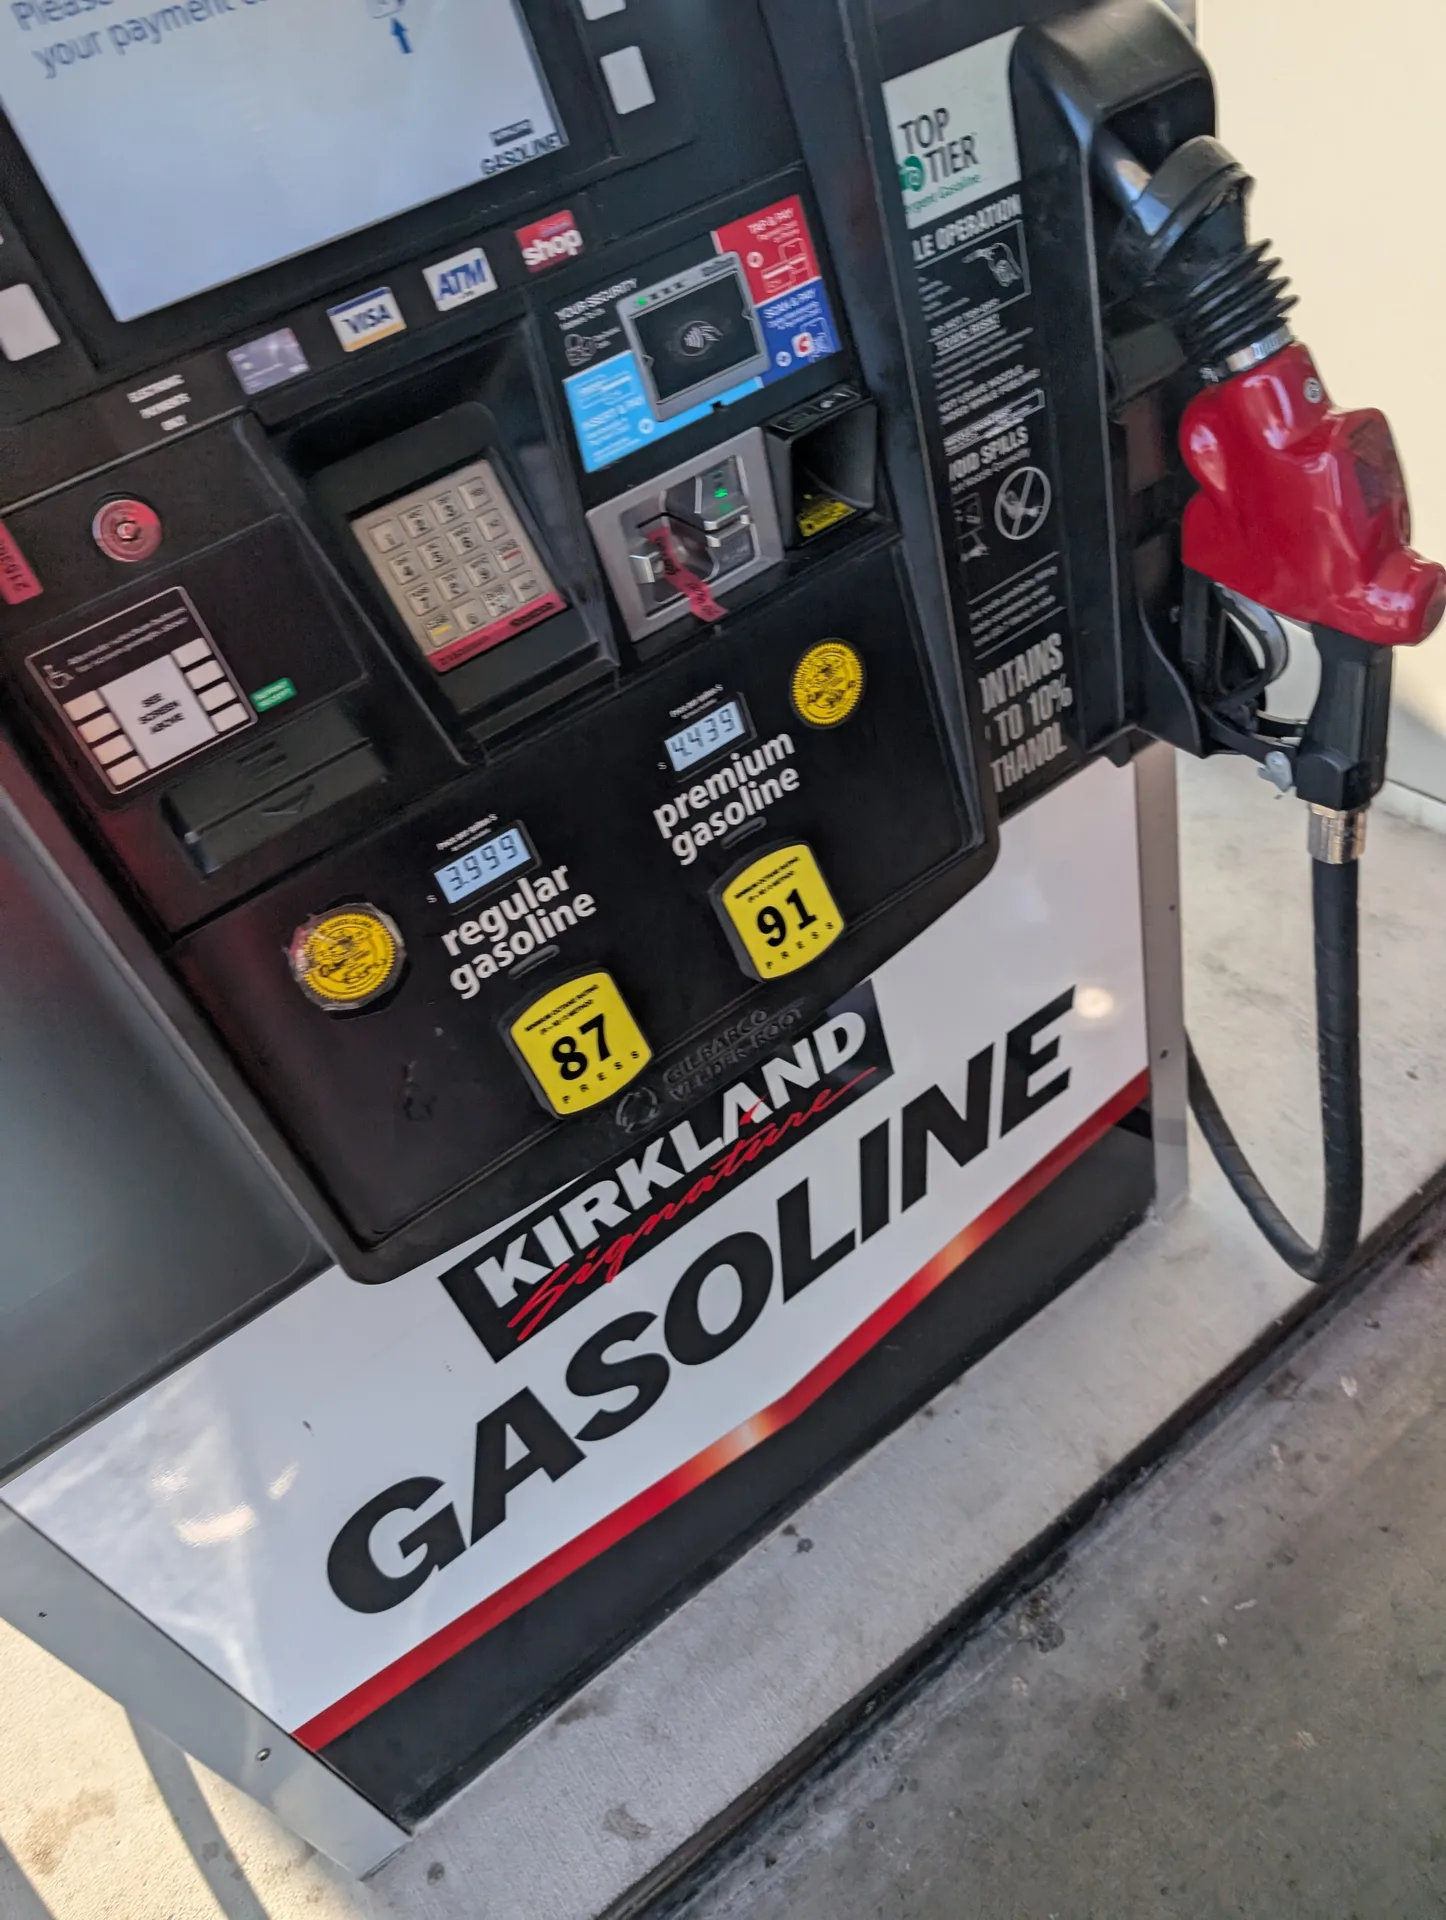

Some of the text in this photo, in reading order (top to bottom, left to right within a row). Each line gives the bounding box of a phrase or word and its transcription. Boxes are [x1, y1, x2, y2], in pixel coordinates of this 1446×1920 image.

[31, 30, 102, 79] your
[899, 107, 949, 154] TOP
[923, 135, 980, 183] TIER
[521, 229, 584, 266] shop
[436, 257, 487, 300] ATM
[340, 304, 394, 334] VISA
[980, 426, 1029, 467] SPILLS
[1027, 673, 1072, 724] 10%
[653, 734, 795, 838] premium
[672, 767, 800, 865] gasoline
[444, 834, 518, 892] 3.999
[441, 865, 568, 956] regular
[757, 888, 818, 947] 91
[450, 893, 596, 999] gasoline
[552, 1013, 611, 1080] 87
[662, 1009, 768, 1084] GILBARCO
[561, 1050, 640, 1104] PRESS
[473, 1011, 867, 1309] KIRKLAND
[506, 1066, 877, 1342] Signature
[326, 984, 1075, 1615] GASOLINE
